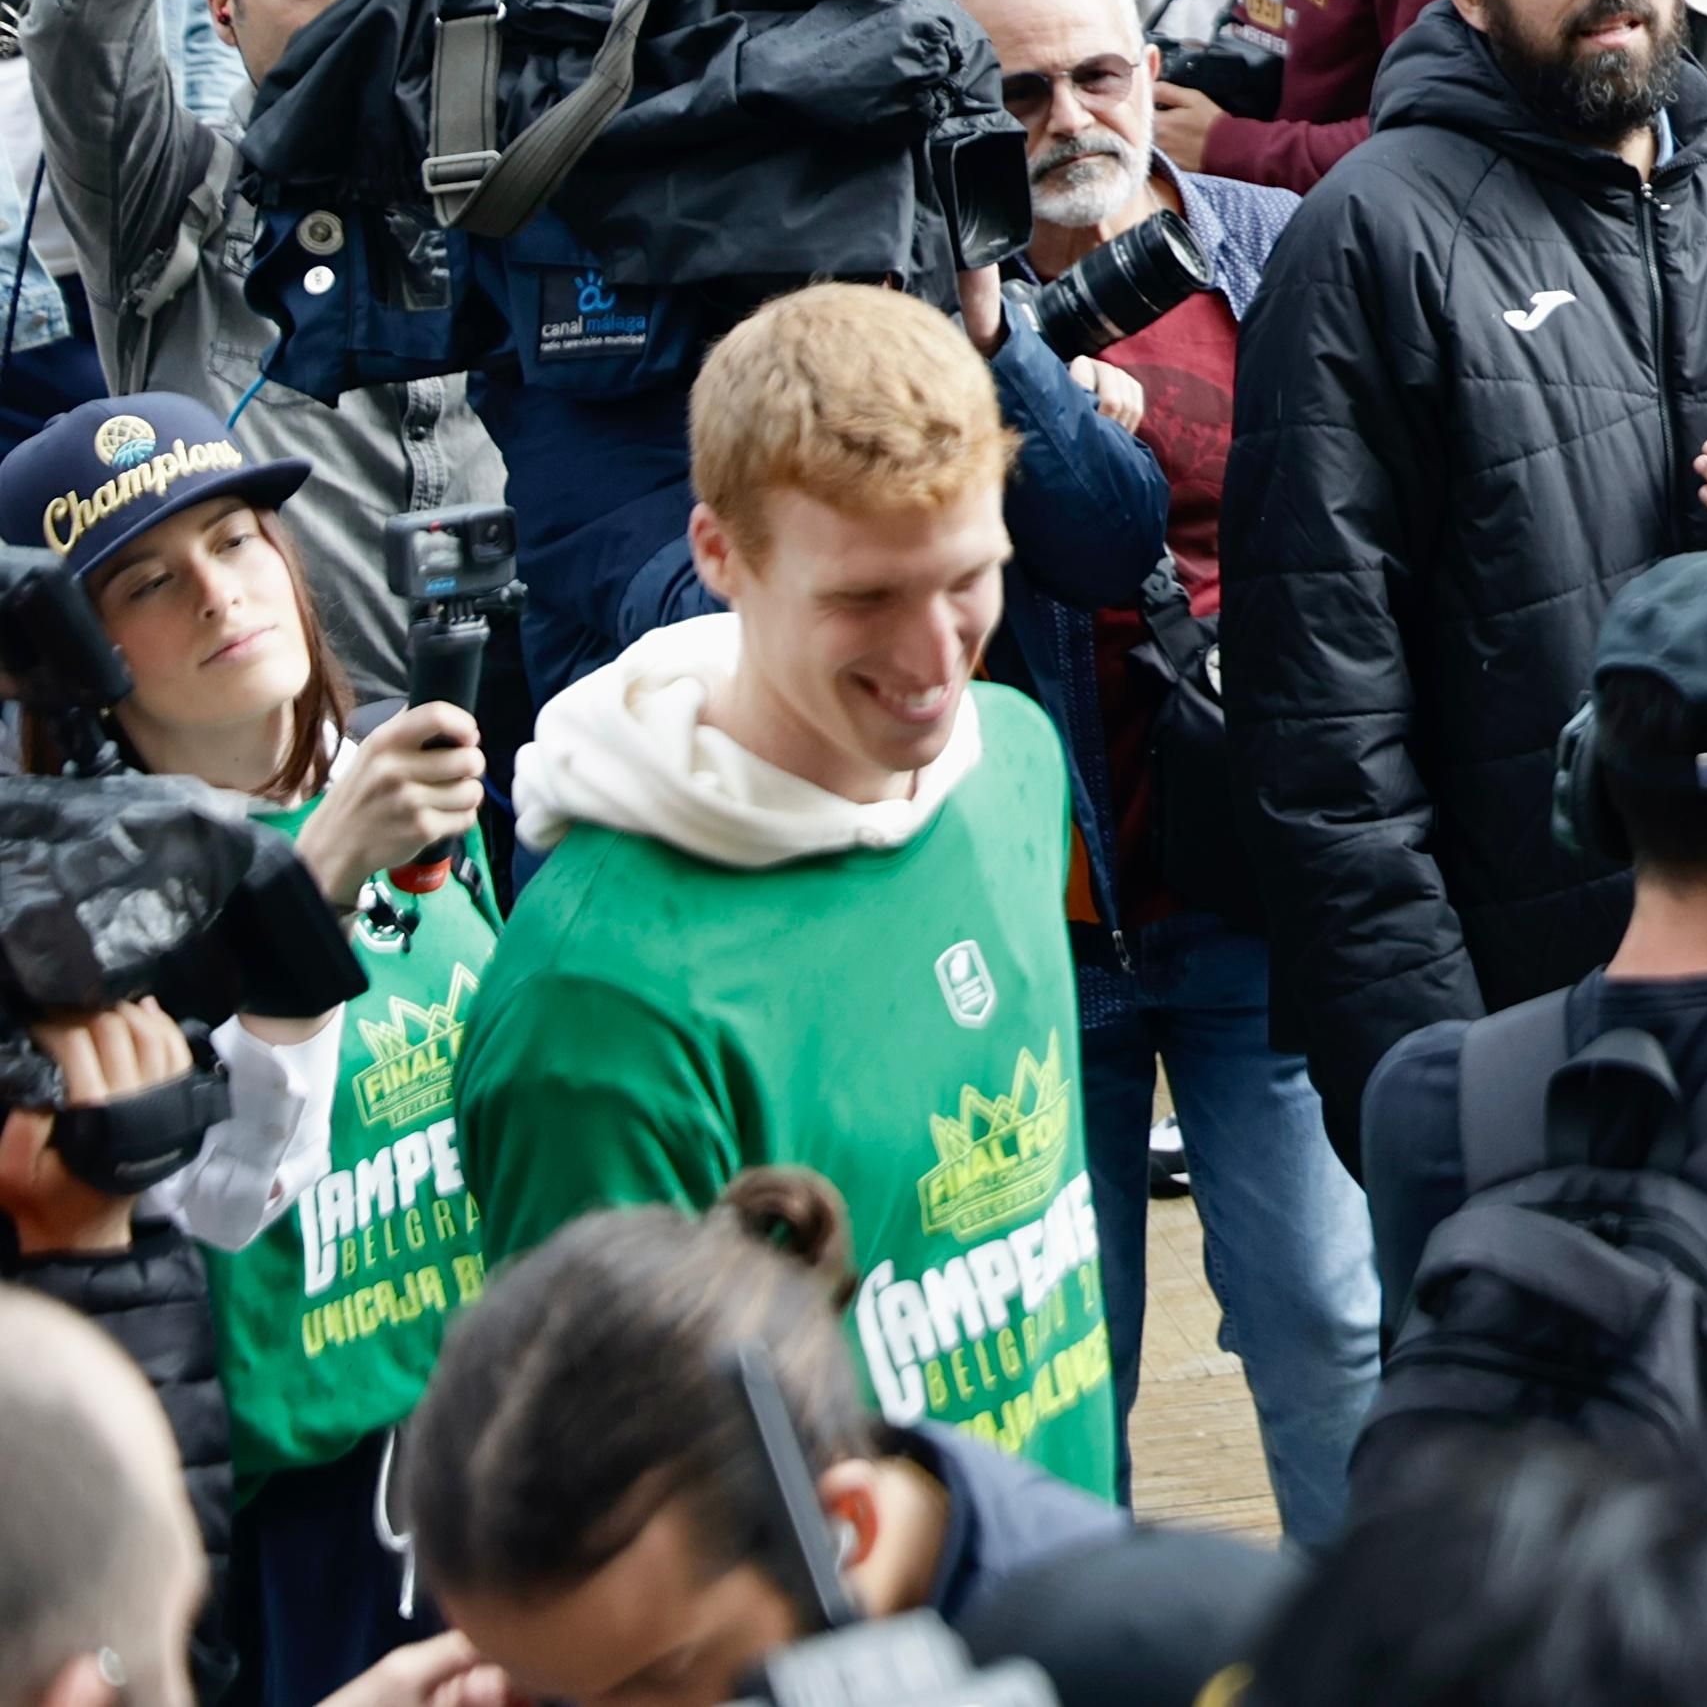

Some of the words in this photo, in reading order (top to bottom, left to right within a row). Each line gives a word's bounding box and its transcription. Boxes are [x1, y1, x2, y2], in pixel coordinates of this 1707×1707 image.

[541, 315, 584, 338] canal
[585, 313, 646, 333] málaga
[43, 438, 243, 558] Champions
[364, 1041, 448, 1103] FINAL
[300, 1116, 465, 1298] CAMPE
[929, 1138, 1018, 1208] FINAL
[341, 1191, 480, 1279] BELGRA
[302, 1267, 447, 1358] UNICAJA
